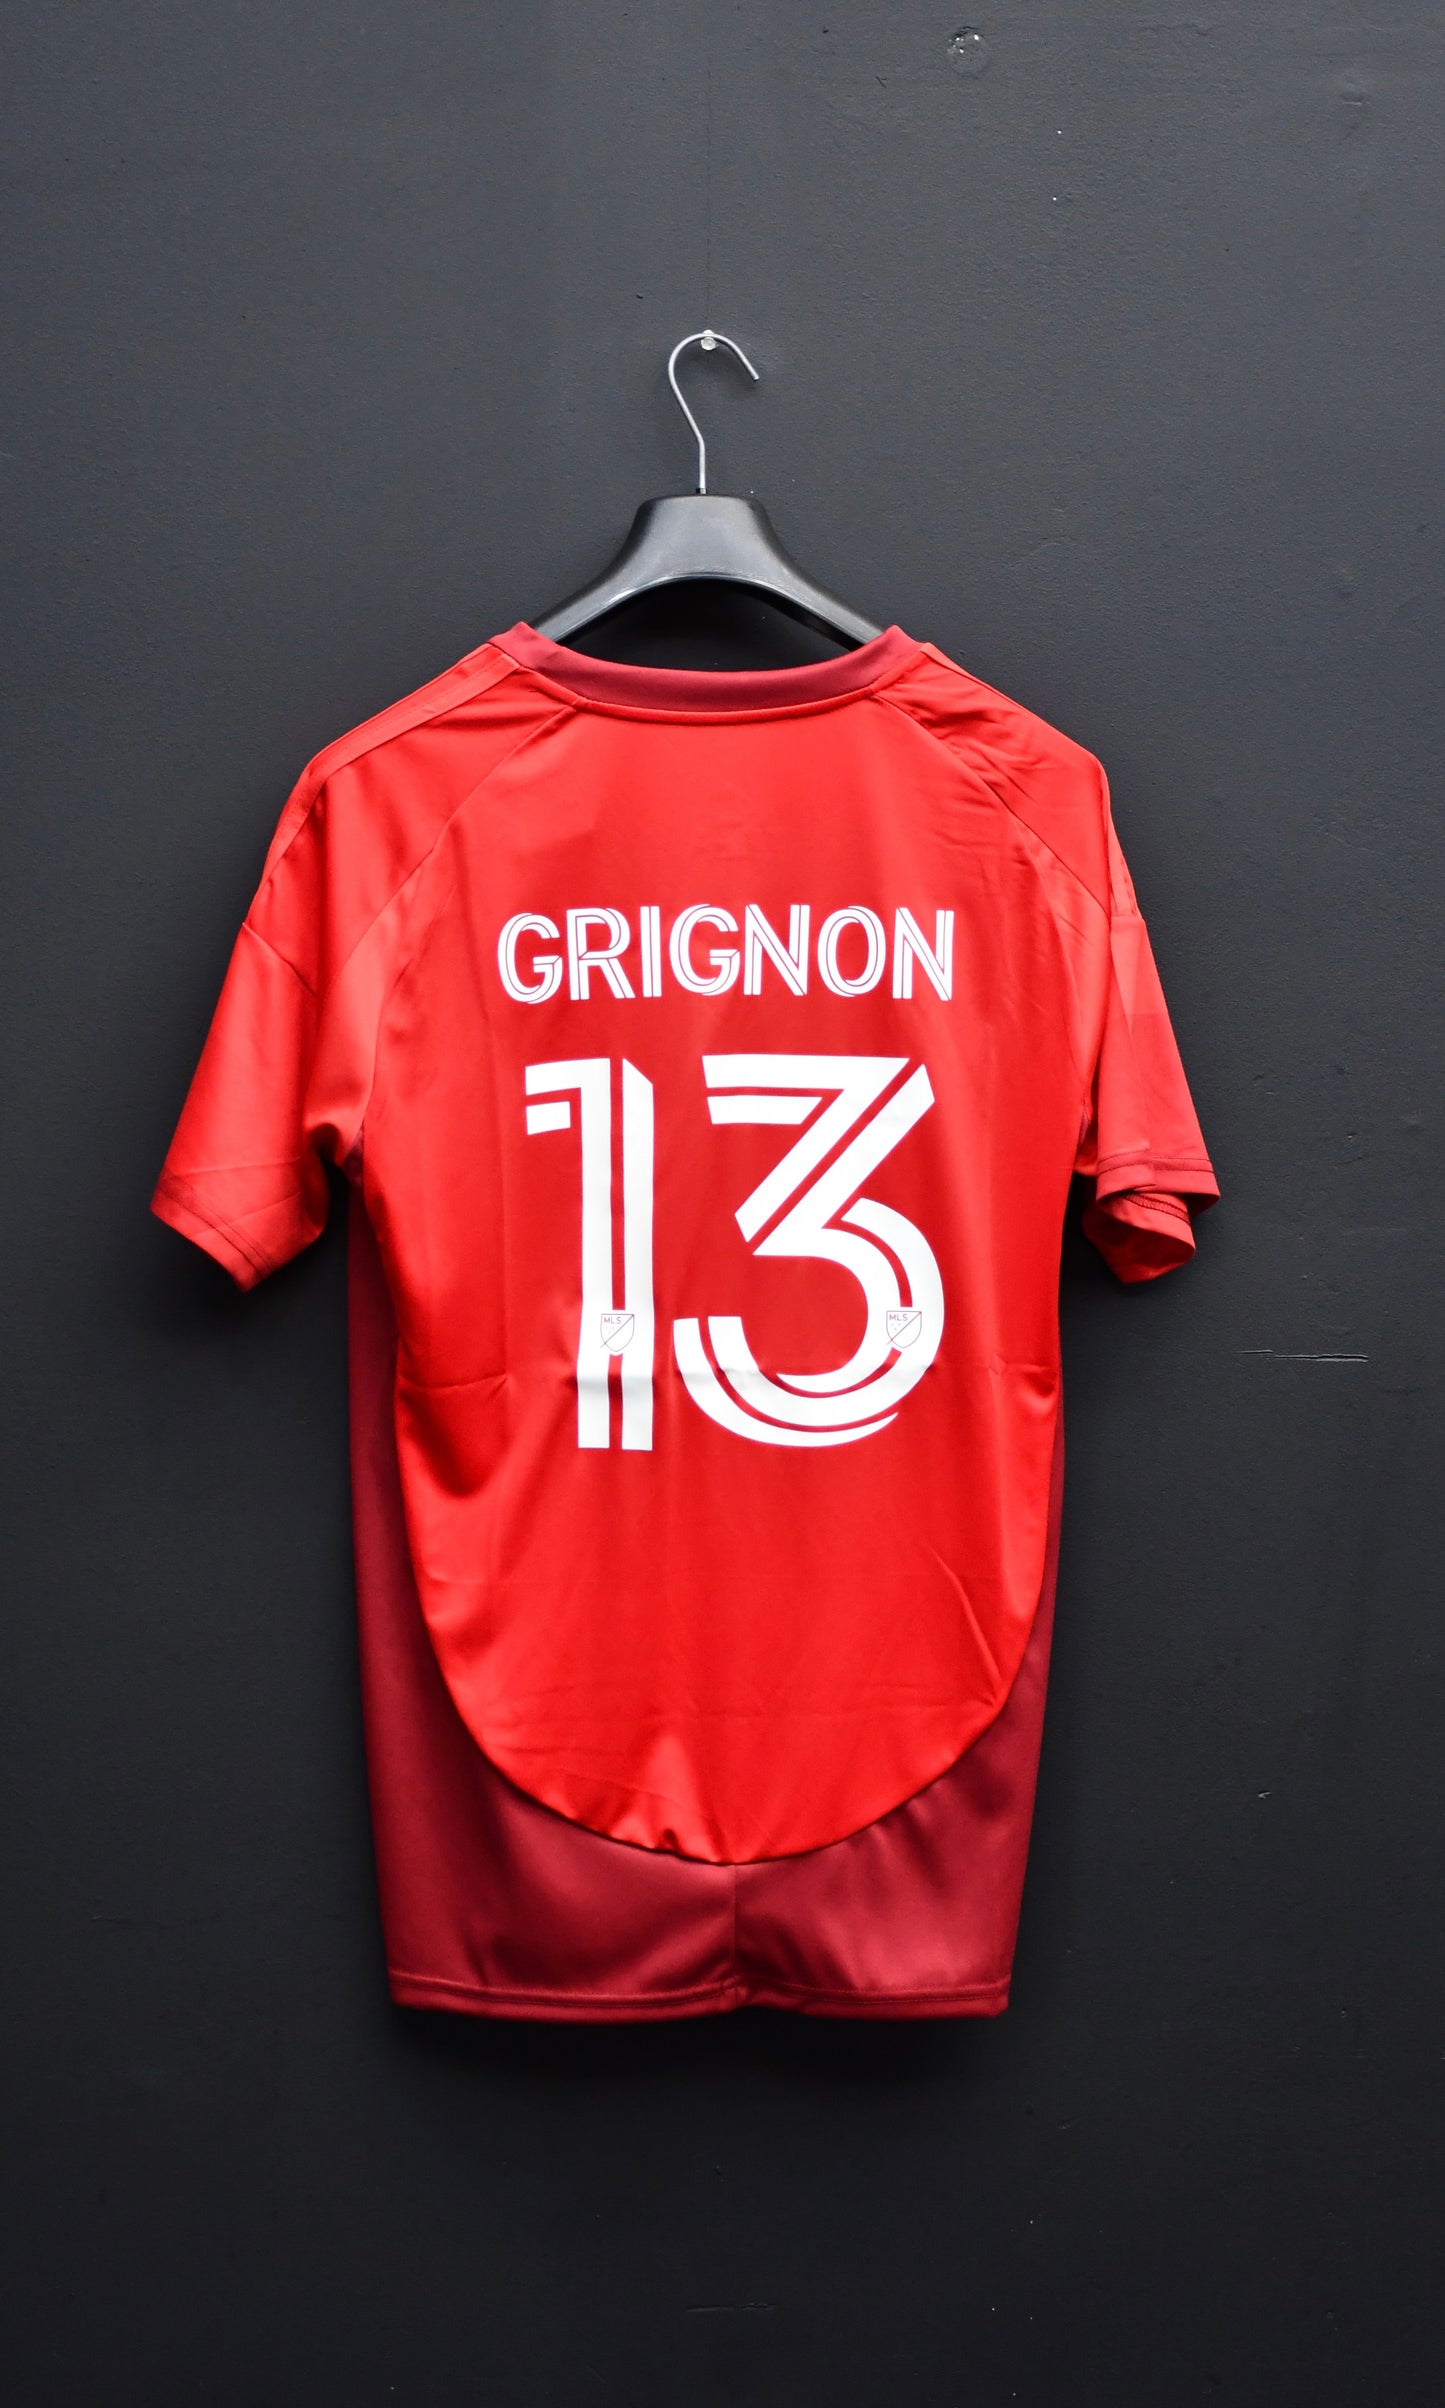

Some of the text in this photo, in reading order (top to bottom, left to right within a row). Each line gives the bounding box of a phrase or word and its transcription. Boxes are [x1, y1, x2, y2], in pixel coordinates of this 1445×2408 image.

[497, 903, 955, 1004] GRIGNON
[524, 1053, 945, 1451] 13
[603, 1316, 622, 1325] MLS
[888, 1313, 908, 1321] MLS
